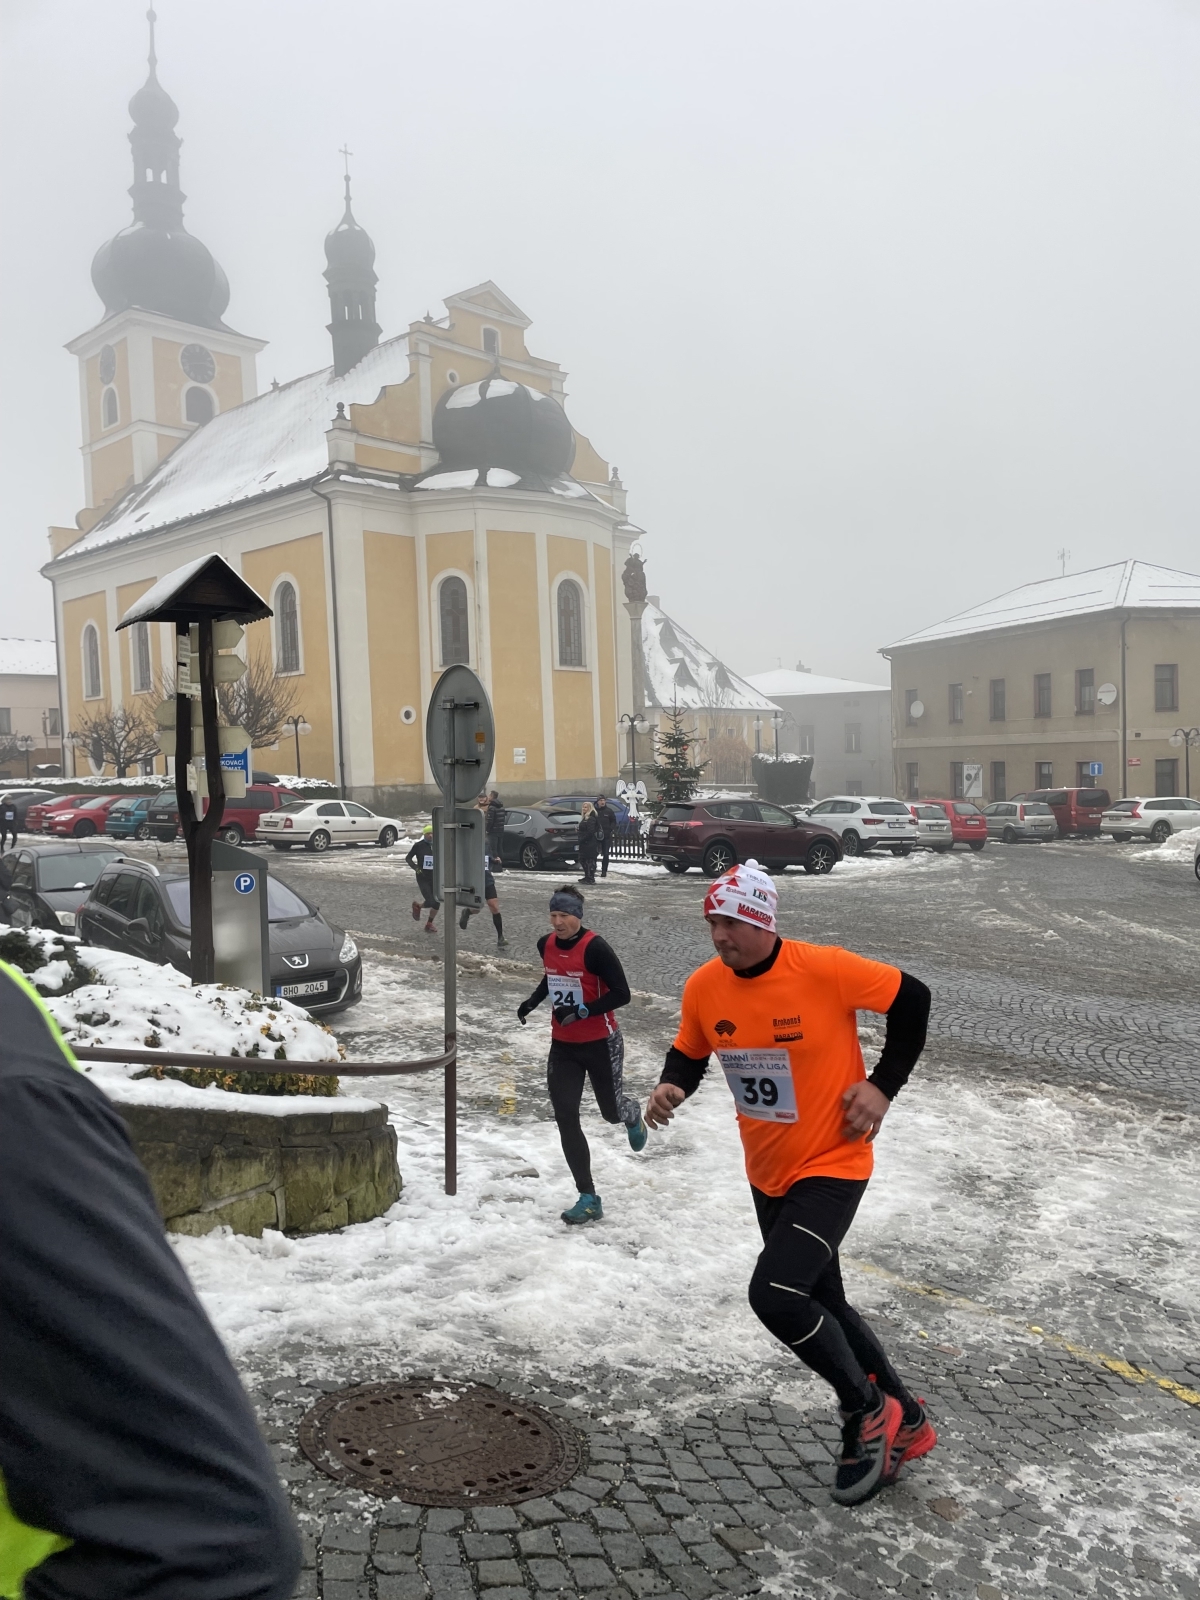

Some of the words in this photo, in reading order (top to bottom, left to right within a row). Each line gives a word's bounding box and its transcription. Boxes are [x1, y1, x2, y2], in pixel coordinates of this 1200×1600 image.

[240, 877, 251, 891] P
[752, 888, 768, 902] LES
[738, 903, 773, 922] MARATON
[304, 982, 324, 993] 2045
[554, 991, 575, 1006] 24
[773, 1031, 803, 1040] MARATON
[720, 1053, 749, 1062] ZIMNÍ
[740, 1077, 778, 1106] 39
